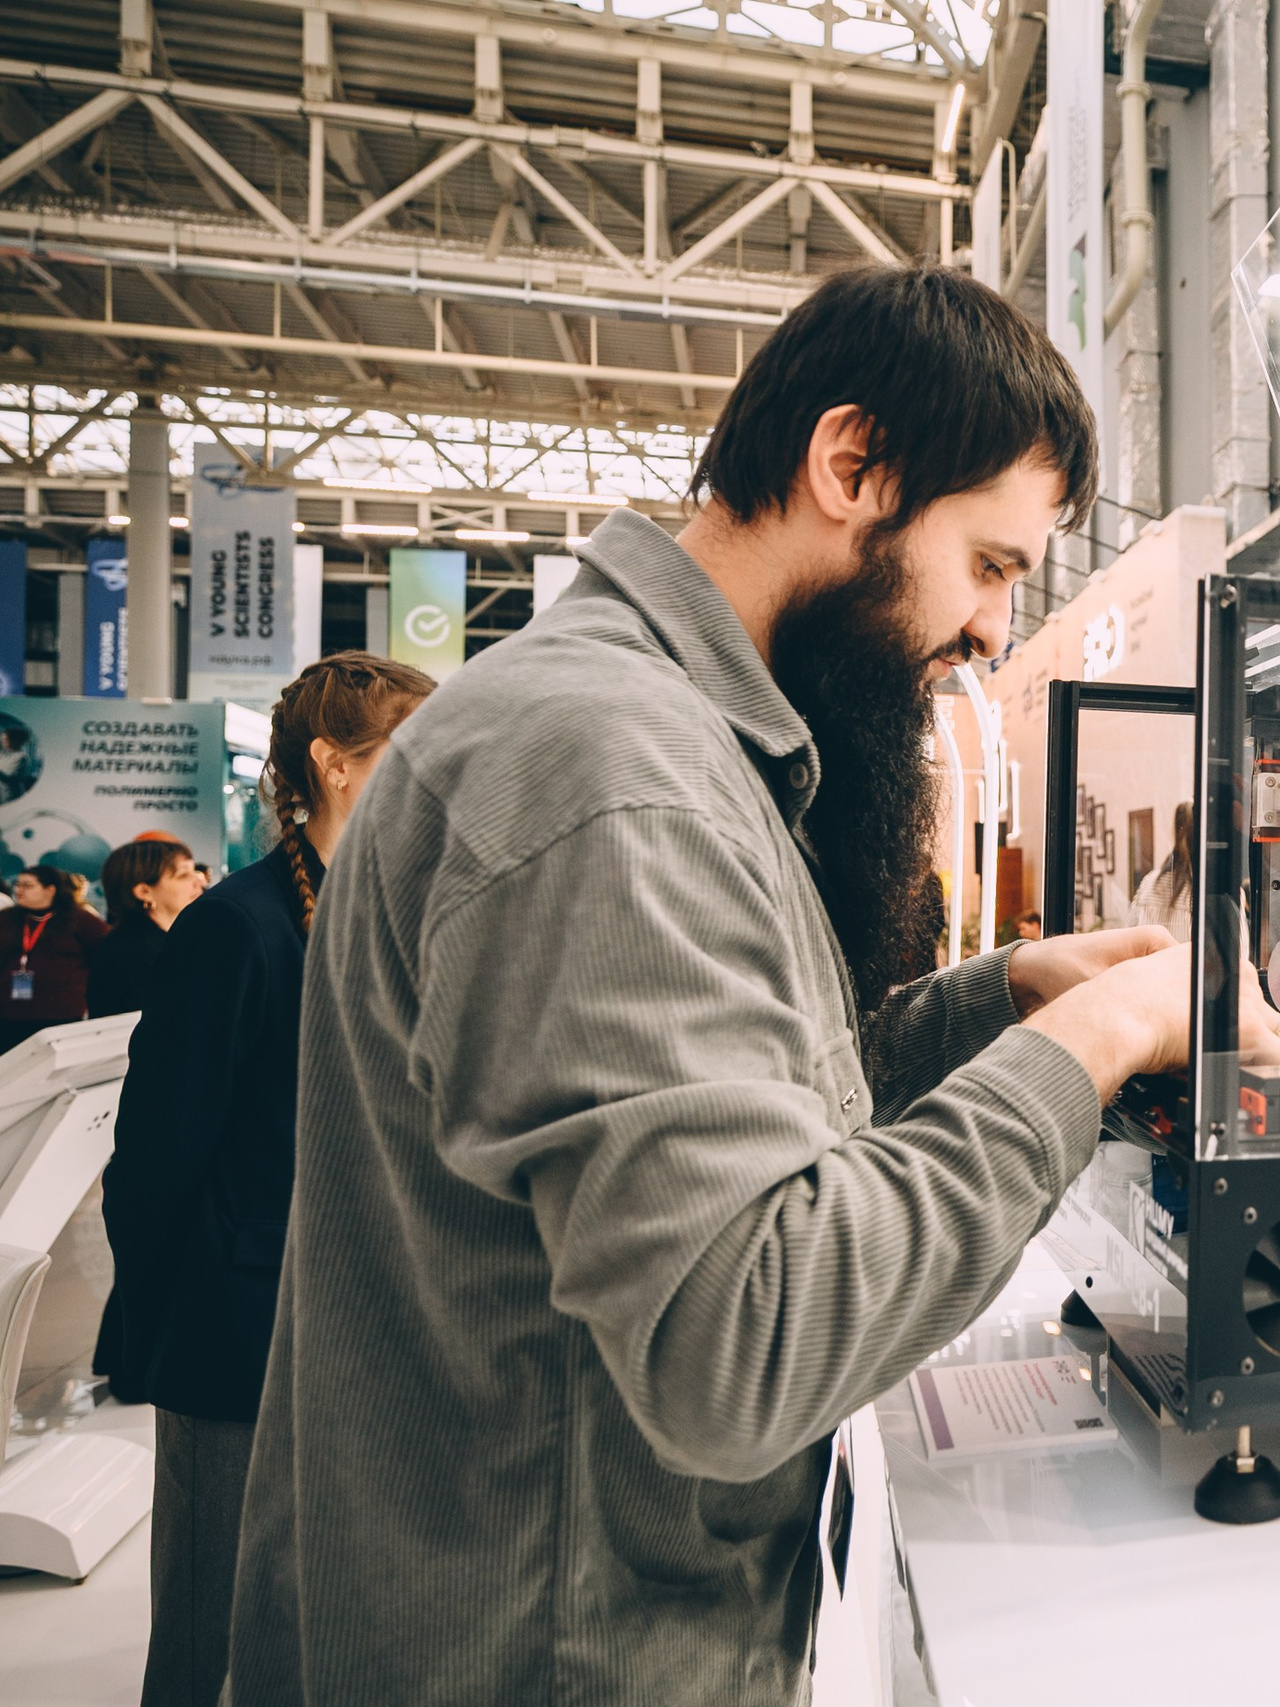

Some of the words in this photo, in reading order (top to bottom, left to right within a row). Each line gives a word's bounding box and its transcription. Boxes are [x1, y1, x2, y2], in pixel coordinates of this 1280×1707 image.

[210, 549, 227, 618] YOUNG
[234, 529, 251, 638] SCIENTISTS
[257, 536, 274, 638] CONGRESS
[79, 740, 199, 756] НАДЕЖНЫЕ
[82, 720, 199, 738] СОЗДАВАТЬ
[72, 758, 199, 775] МАТЕРИАЛЫ
